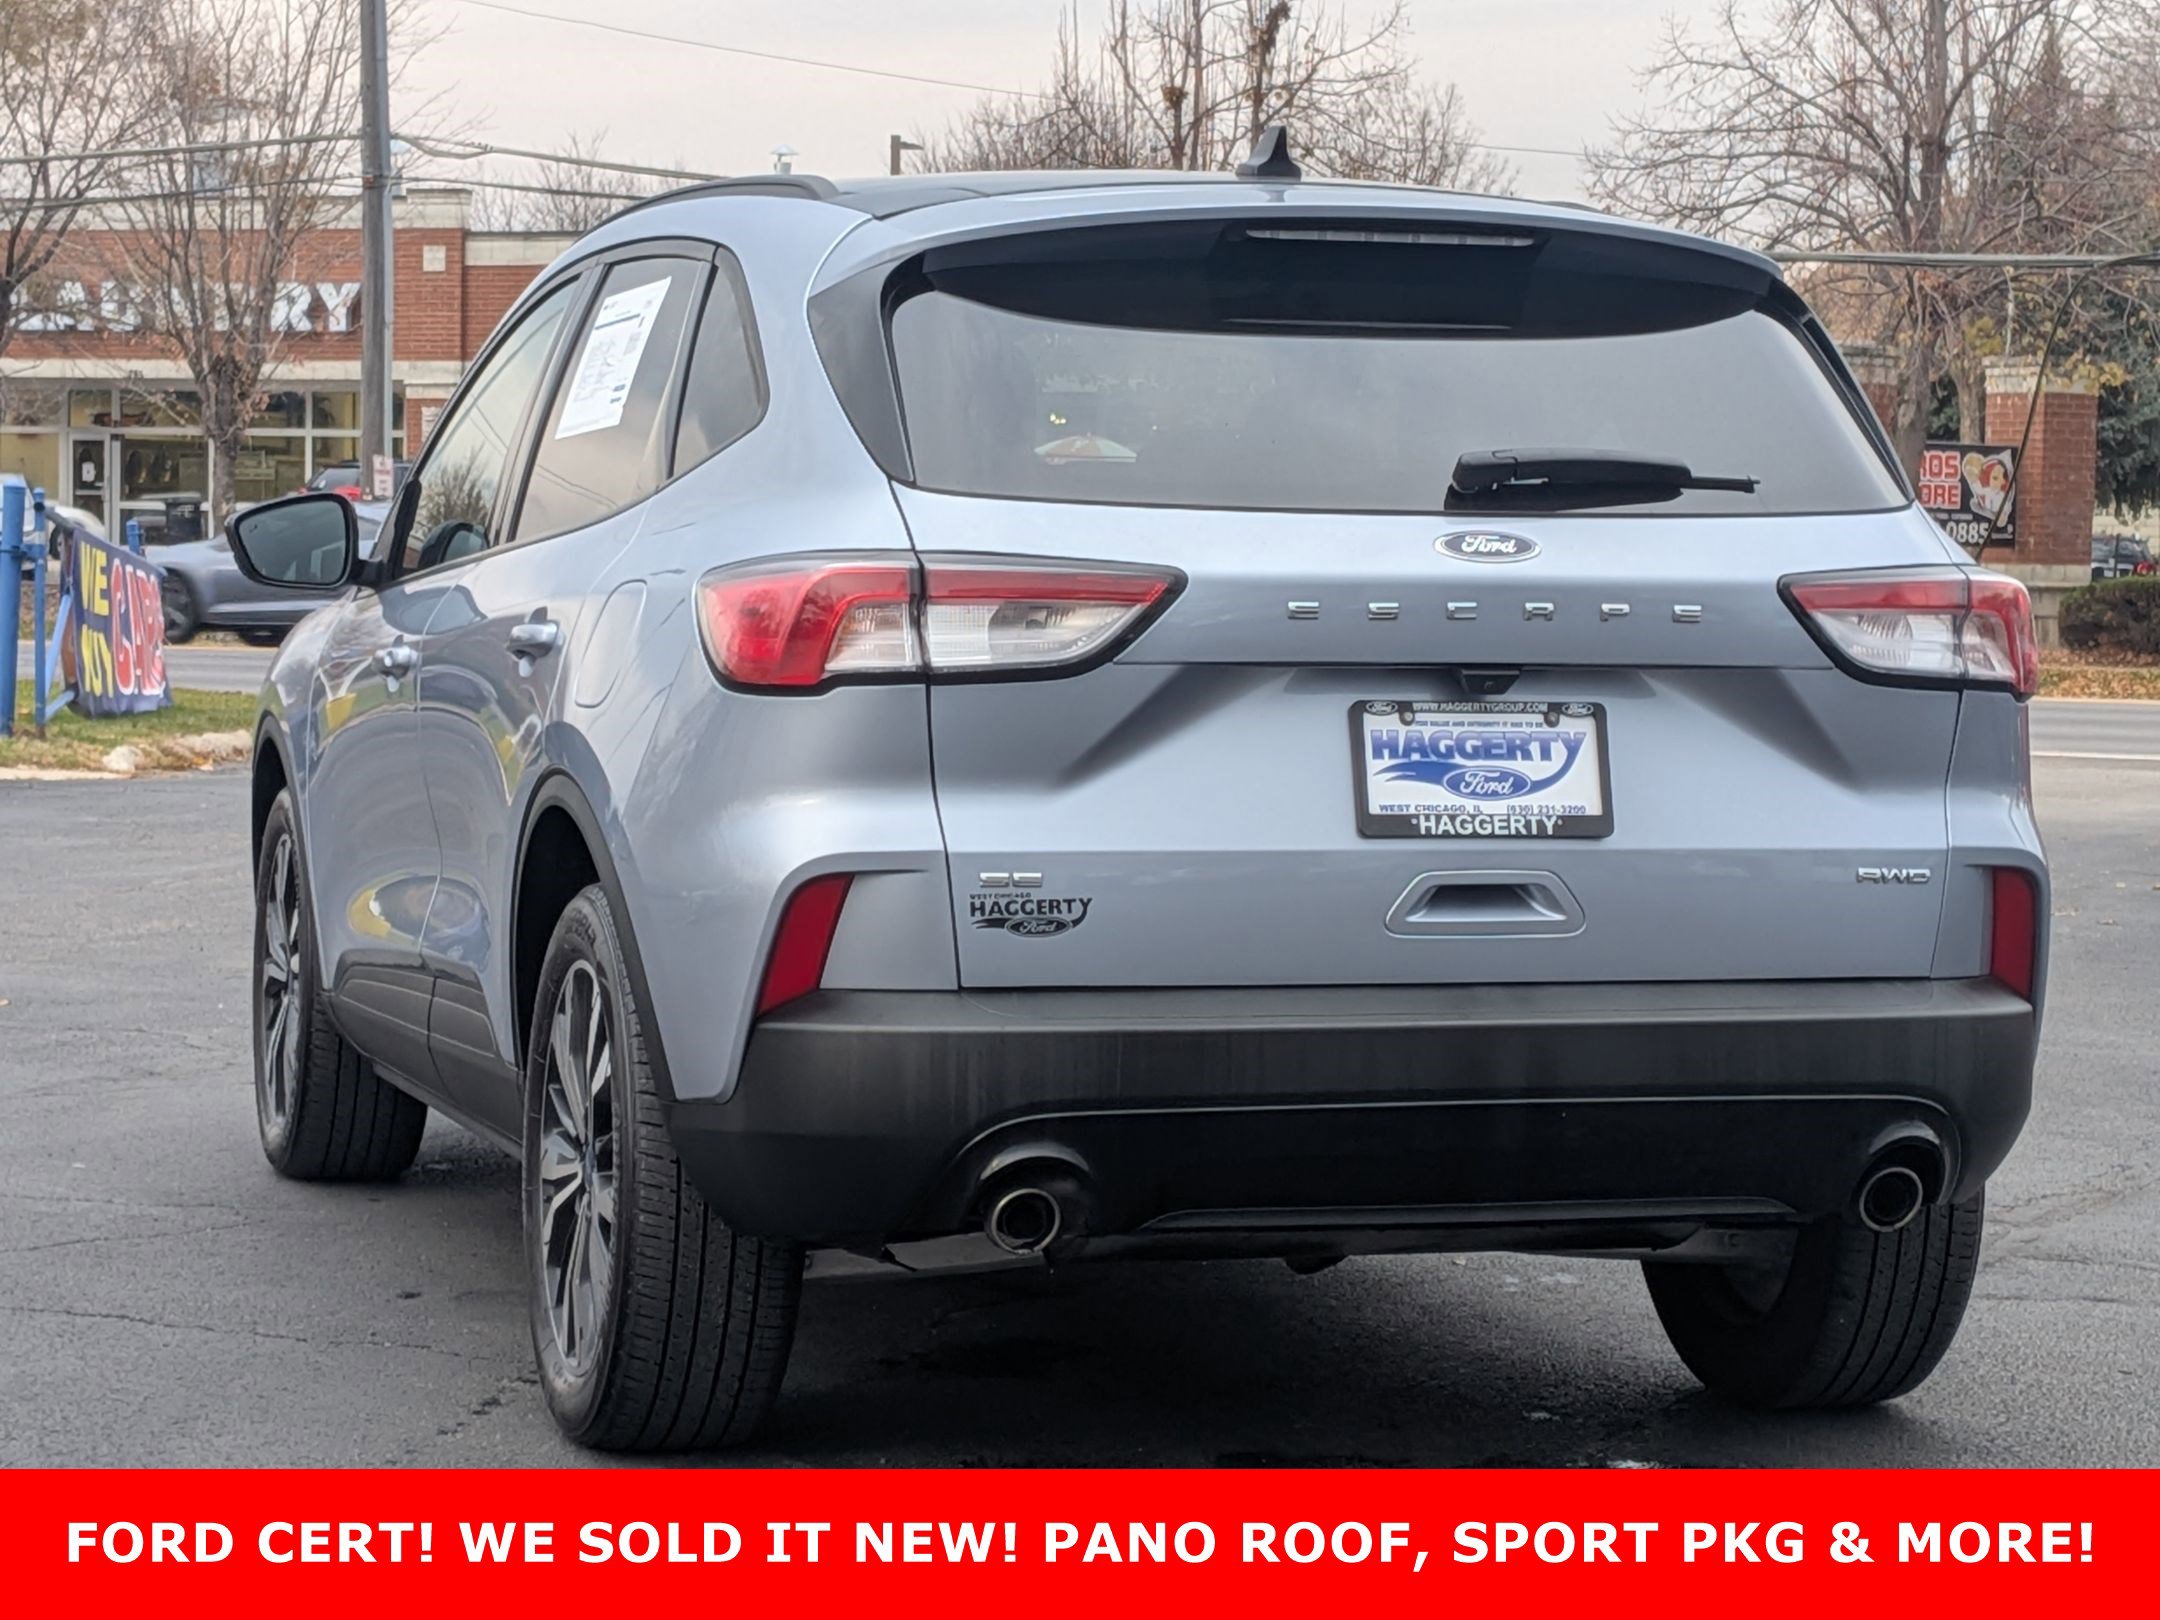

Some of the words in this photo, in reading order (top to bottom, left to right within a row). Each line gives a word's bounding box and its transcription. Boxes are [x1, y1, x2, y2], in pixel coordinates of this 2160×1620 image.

[1461, 534, 1517, 554] Ford
[79, 540, 109, 616] WE
[1288, 601, 1703, 623] ESCAPE
[1412, 702, 1548, 713] WWW.HAGGERTYGROUP.COM
[1370, 729, 1587, 763] HAGGERTY
[1460, 770, 1515, 796] Ford
[1379, 804, 1411, 813] WEST
[1418, 814, 1558, 836] HAGGERTY
[969, 897, 1093, 918] HAGGERTY
[1018, 919, 1058, 934] Ford
